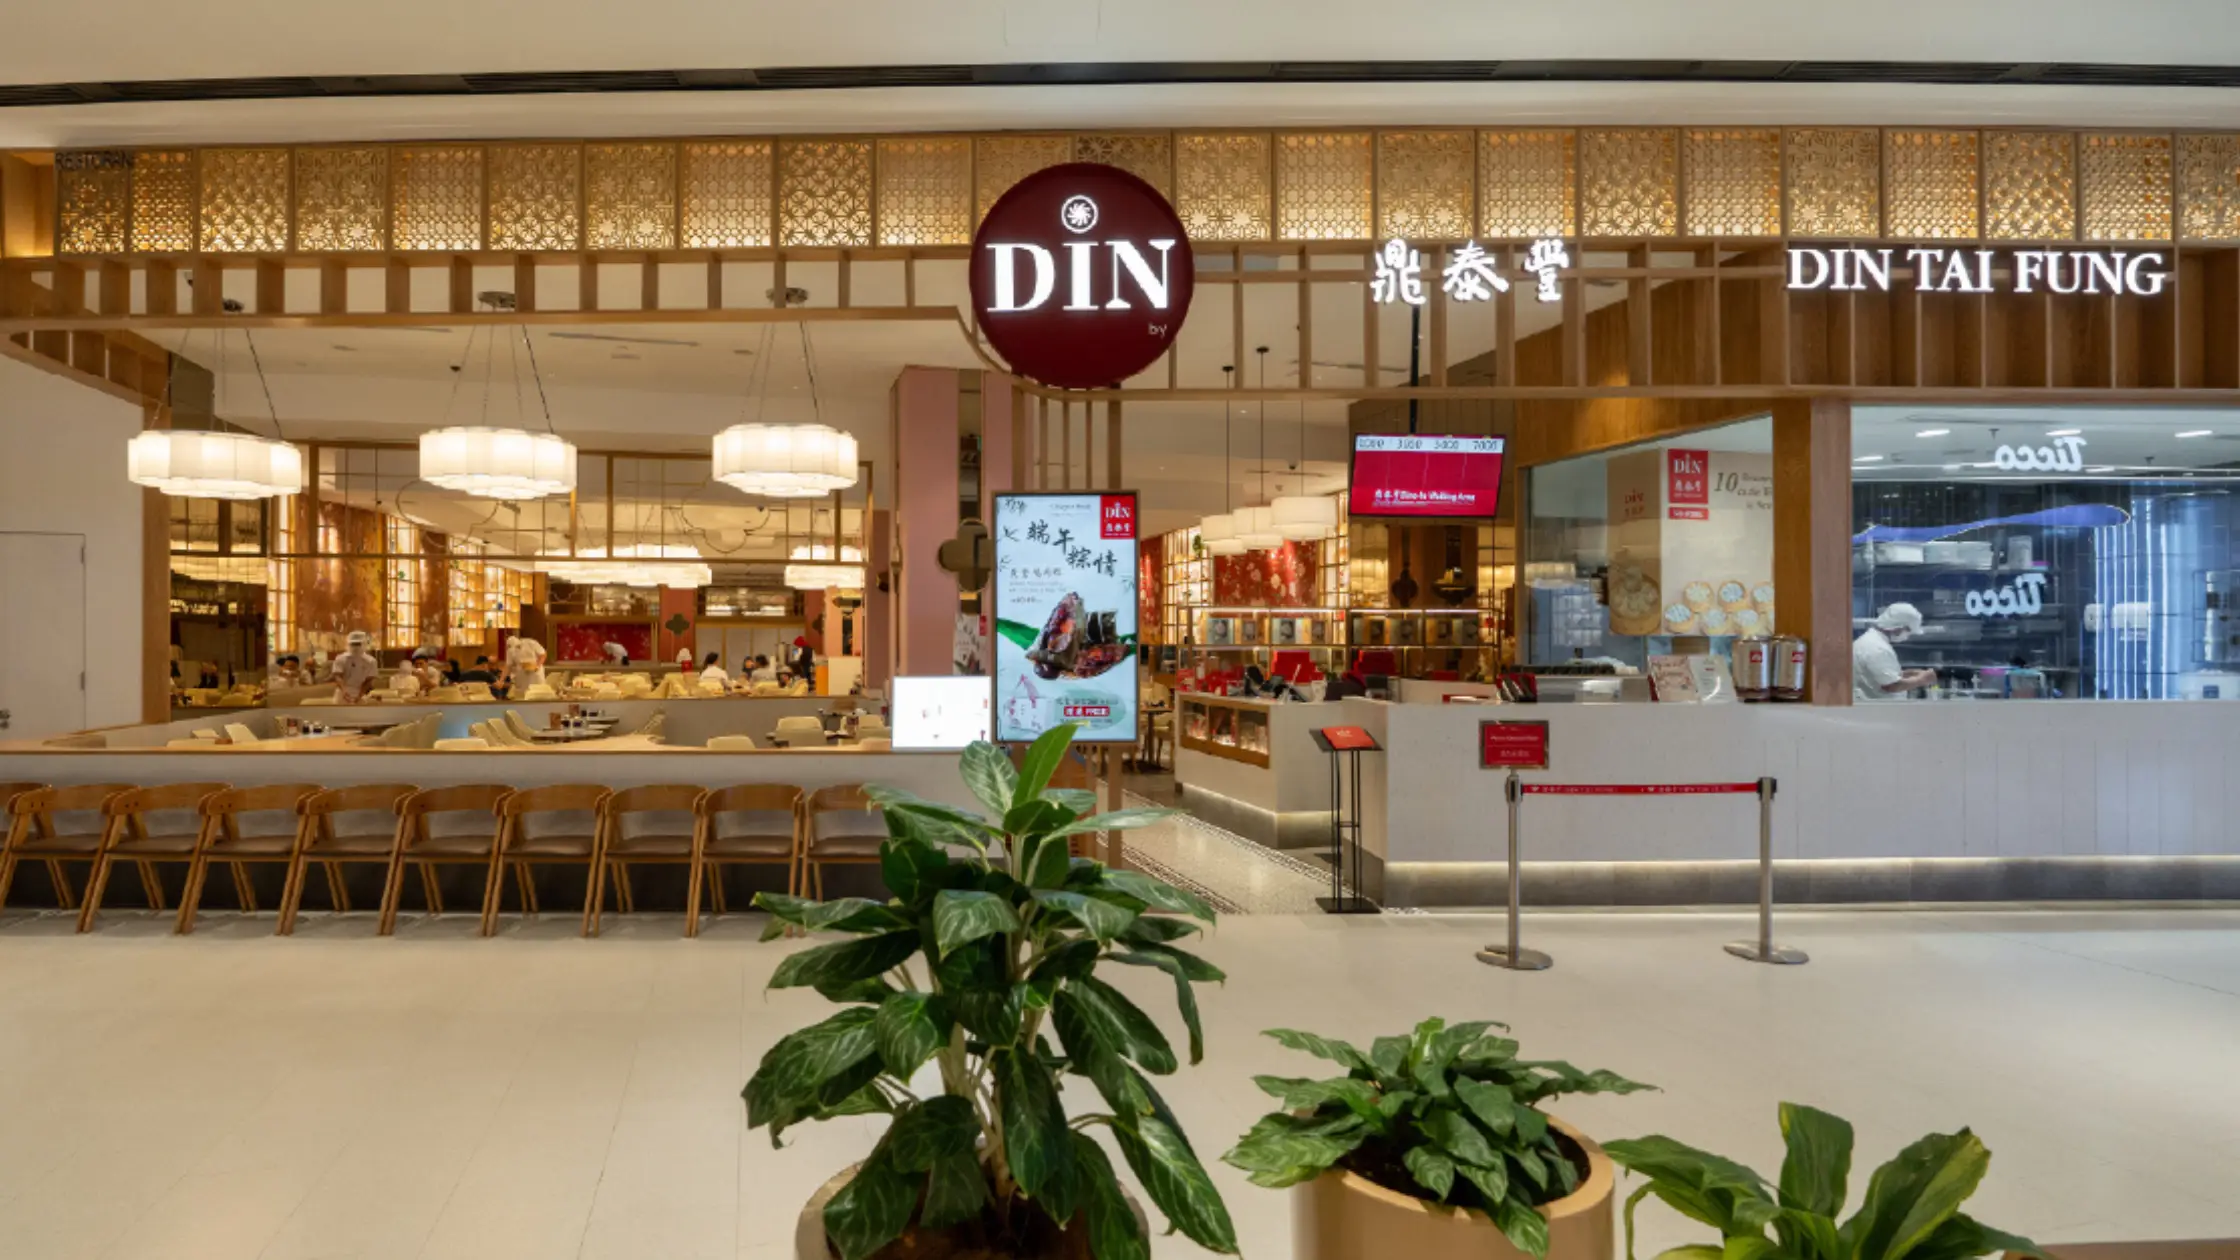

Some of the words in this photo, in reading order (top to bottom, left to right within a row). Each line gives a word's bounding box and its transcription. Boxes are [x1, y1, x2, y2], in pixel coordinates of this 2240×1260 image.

[985, 238, 1176, 312] DIN
[1370, 238, 1569, 305] 鼎泰豐
[1787, 249, 1893, 291] DIN
[1907, 250, 1994, 293] TAI
[2013, 251, 2166, 296] FUNG
[1148, 322, 1168, 338] by
[1714, 472, 1739, 492] 10
